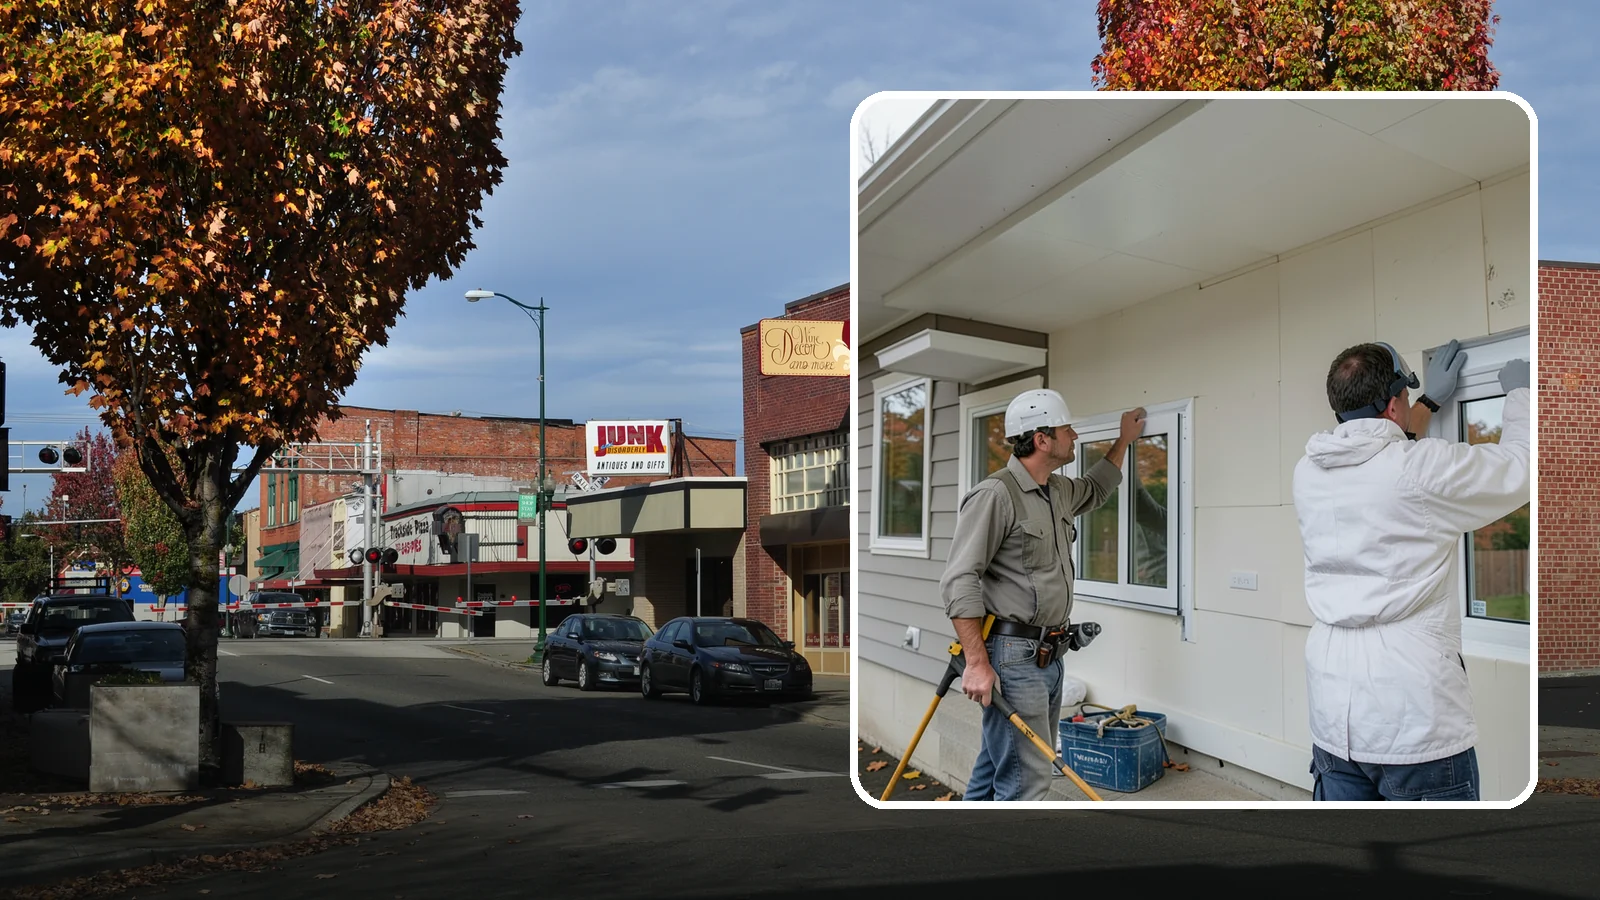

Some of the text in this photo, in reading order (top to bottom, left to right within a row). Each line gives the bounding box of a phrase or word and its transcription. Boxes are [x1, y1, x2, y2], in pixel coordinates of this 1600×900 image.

[765, 327, 831, 365] Decor
[596, 425, 665, 457] JUNK
[607, 446, 646, 454] DISORDERLY
[597, 460, 666, 470] ANTIQUES AND GIFTS
